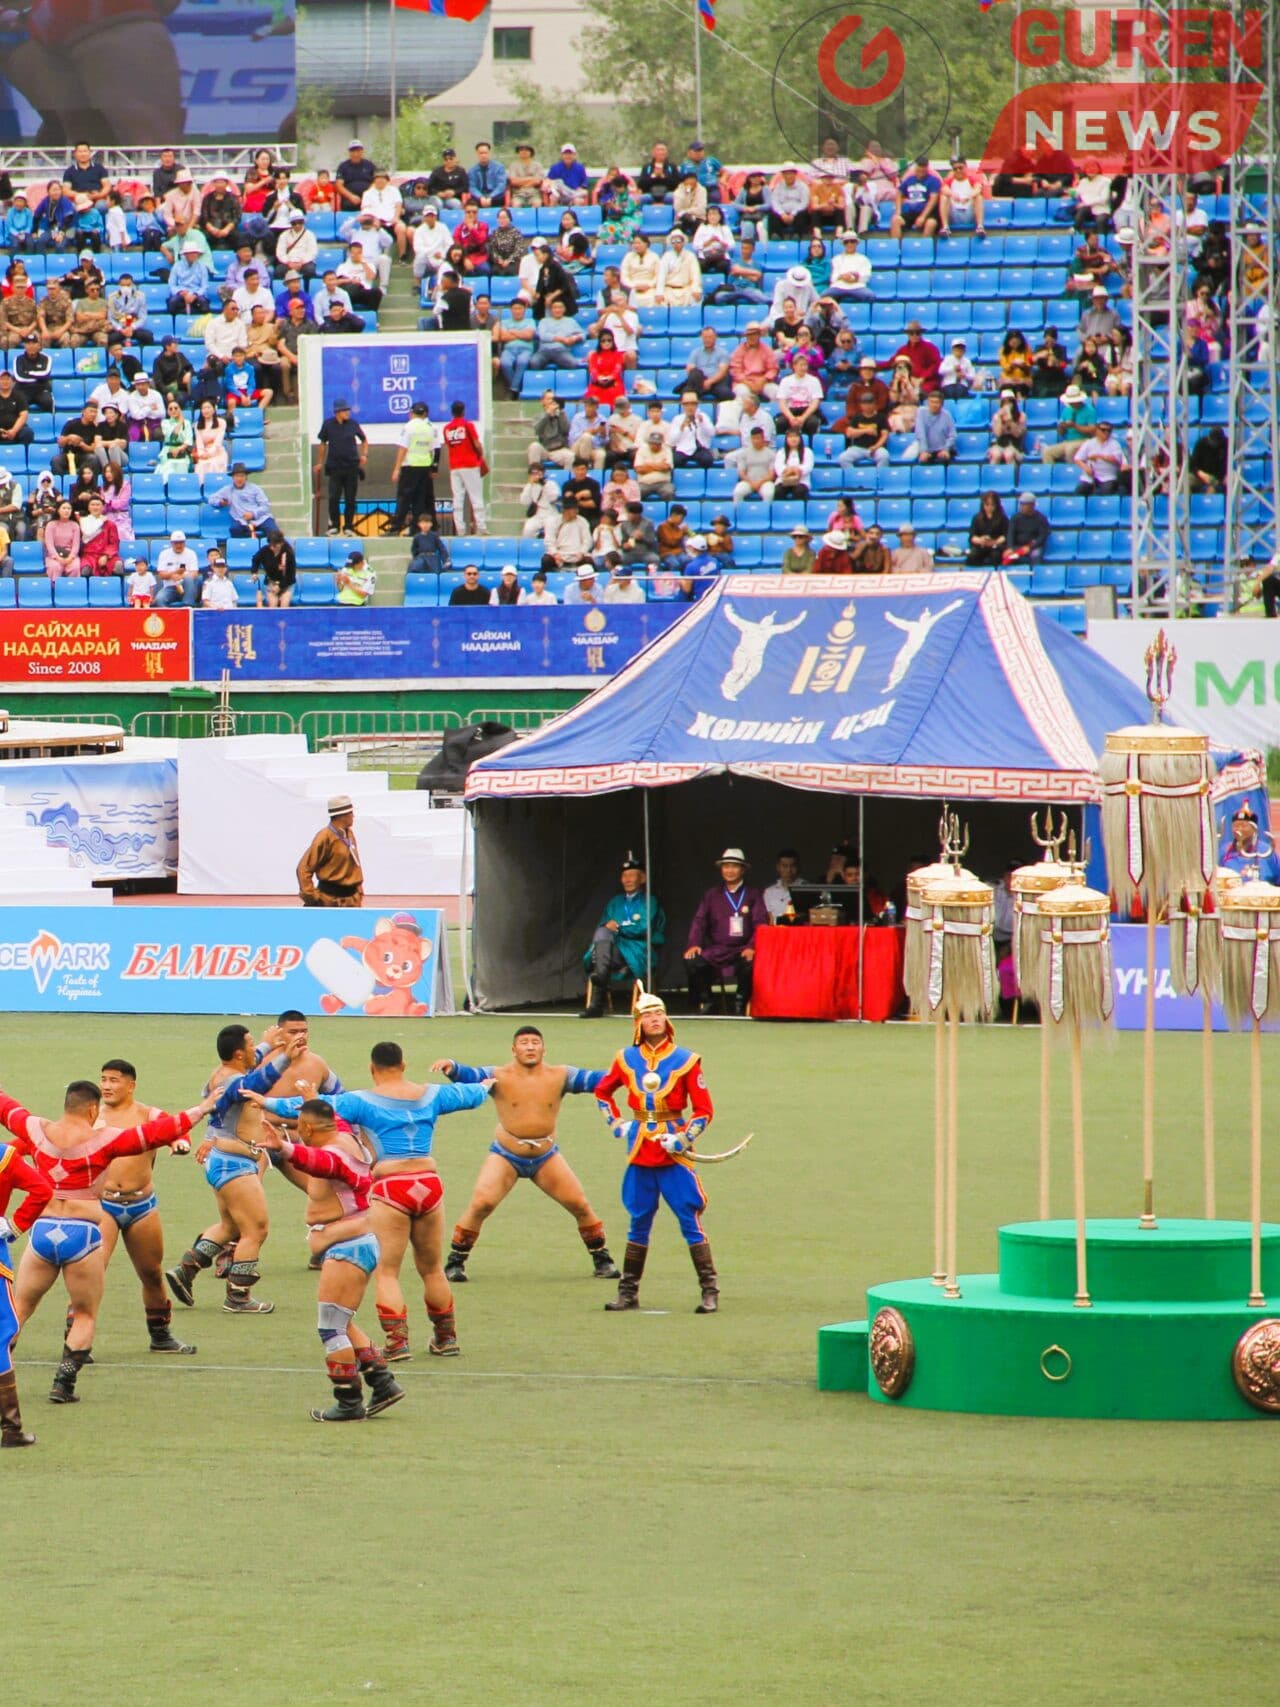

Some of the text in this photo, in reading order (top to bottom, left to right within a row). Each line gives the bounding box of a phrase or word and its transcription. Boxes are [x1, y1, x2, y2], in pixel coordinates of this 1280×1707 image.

[382, 377, 417, 391] EXIT
[393, 398, 408, 410] 13
[23, 620, 101, 638] САЙХАН
[471, 630, 512, 641] САЙХАН
[3, 638, 121, 658] НААДААРАЙ
[461, 640, 522, 652] НААДААРАЙ
[28, 661, 101, 675] Since 2008
[687, 699, 896, 744] ХӨЛИЙН ЦЭЦ
[122, 943, 303, 978] БАМБАР
[88, 973, 100, 988] of
[57, 985, 103, 1000] Happiness
